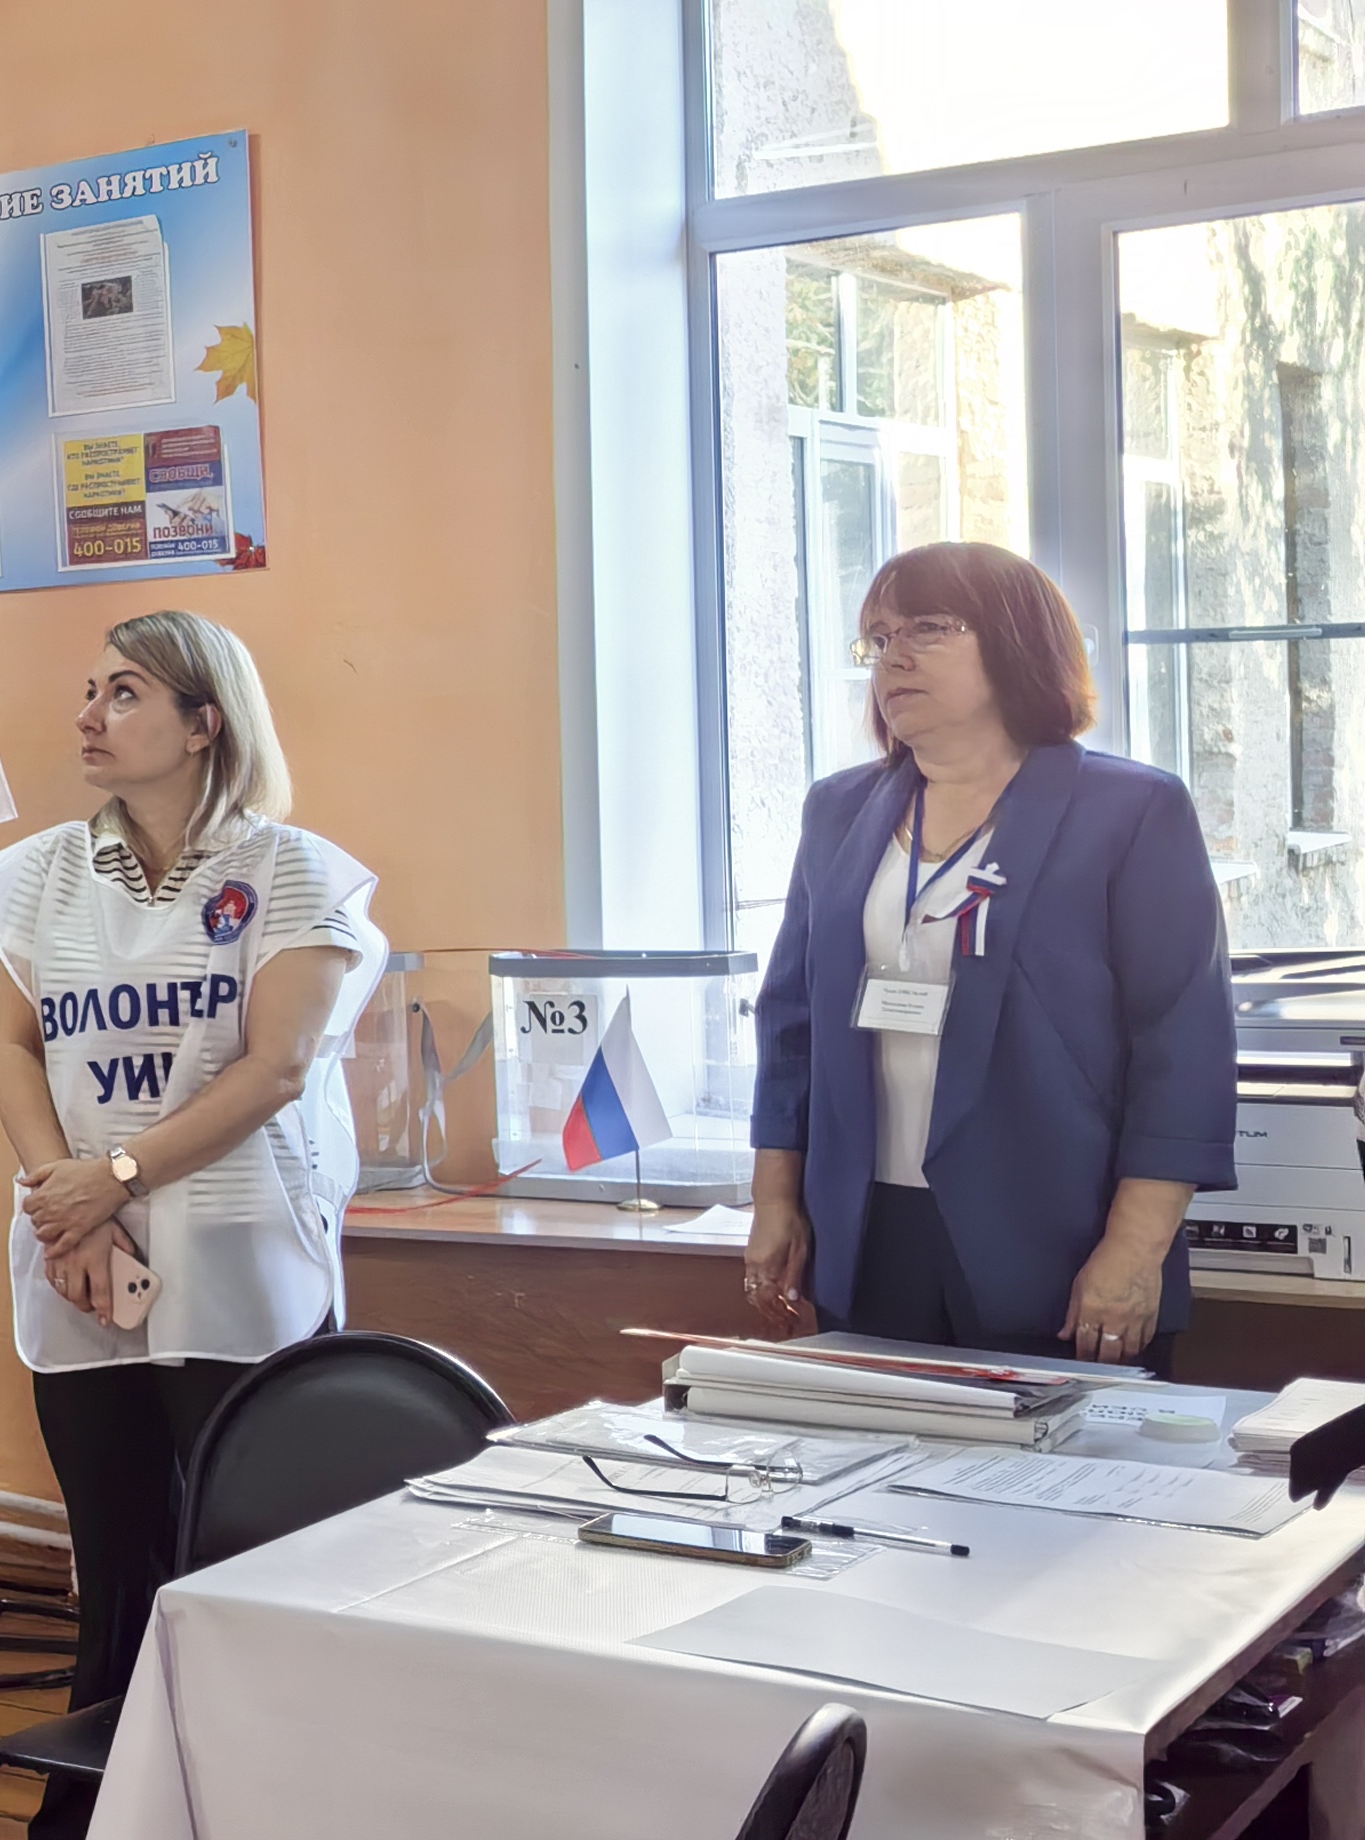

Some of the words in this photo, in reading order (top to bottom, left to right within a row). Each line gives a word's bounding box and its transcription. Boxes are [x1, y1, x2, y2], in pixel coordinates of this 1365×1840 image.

[50, 152, 220, 210] ЗАНЯТИЙ
[153, 523, 214, 539] ПОЗВОНИ
[73, 537, 142, 558] 400-015
[177, 539, 219, 551] 400-015
[519, 1000, 588, 1035] №3
[1238, 1130, 1268, 1138] TUM
